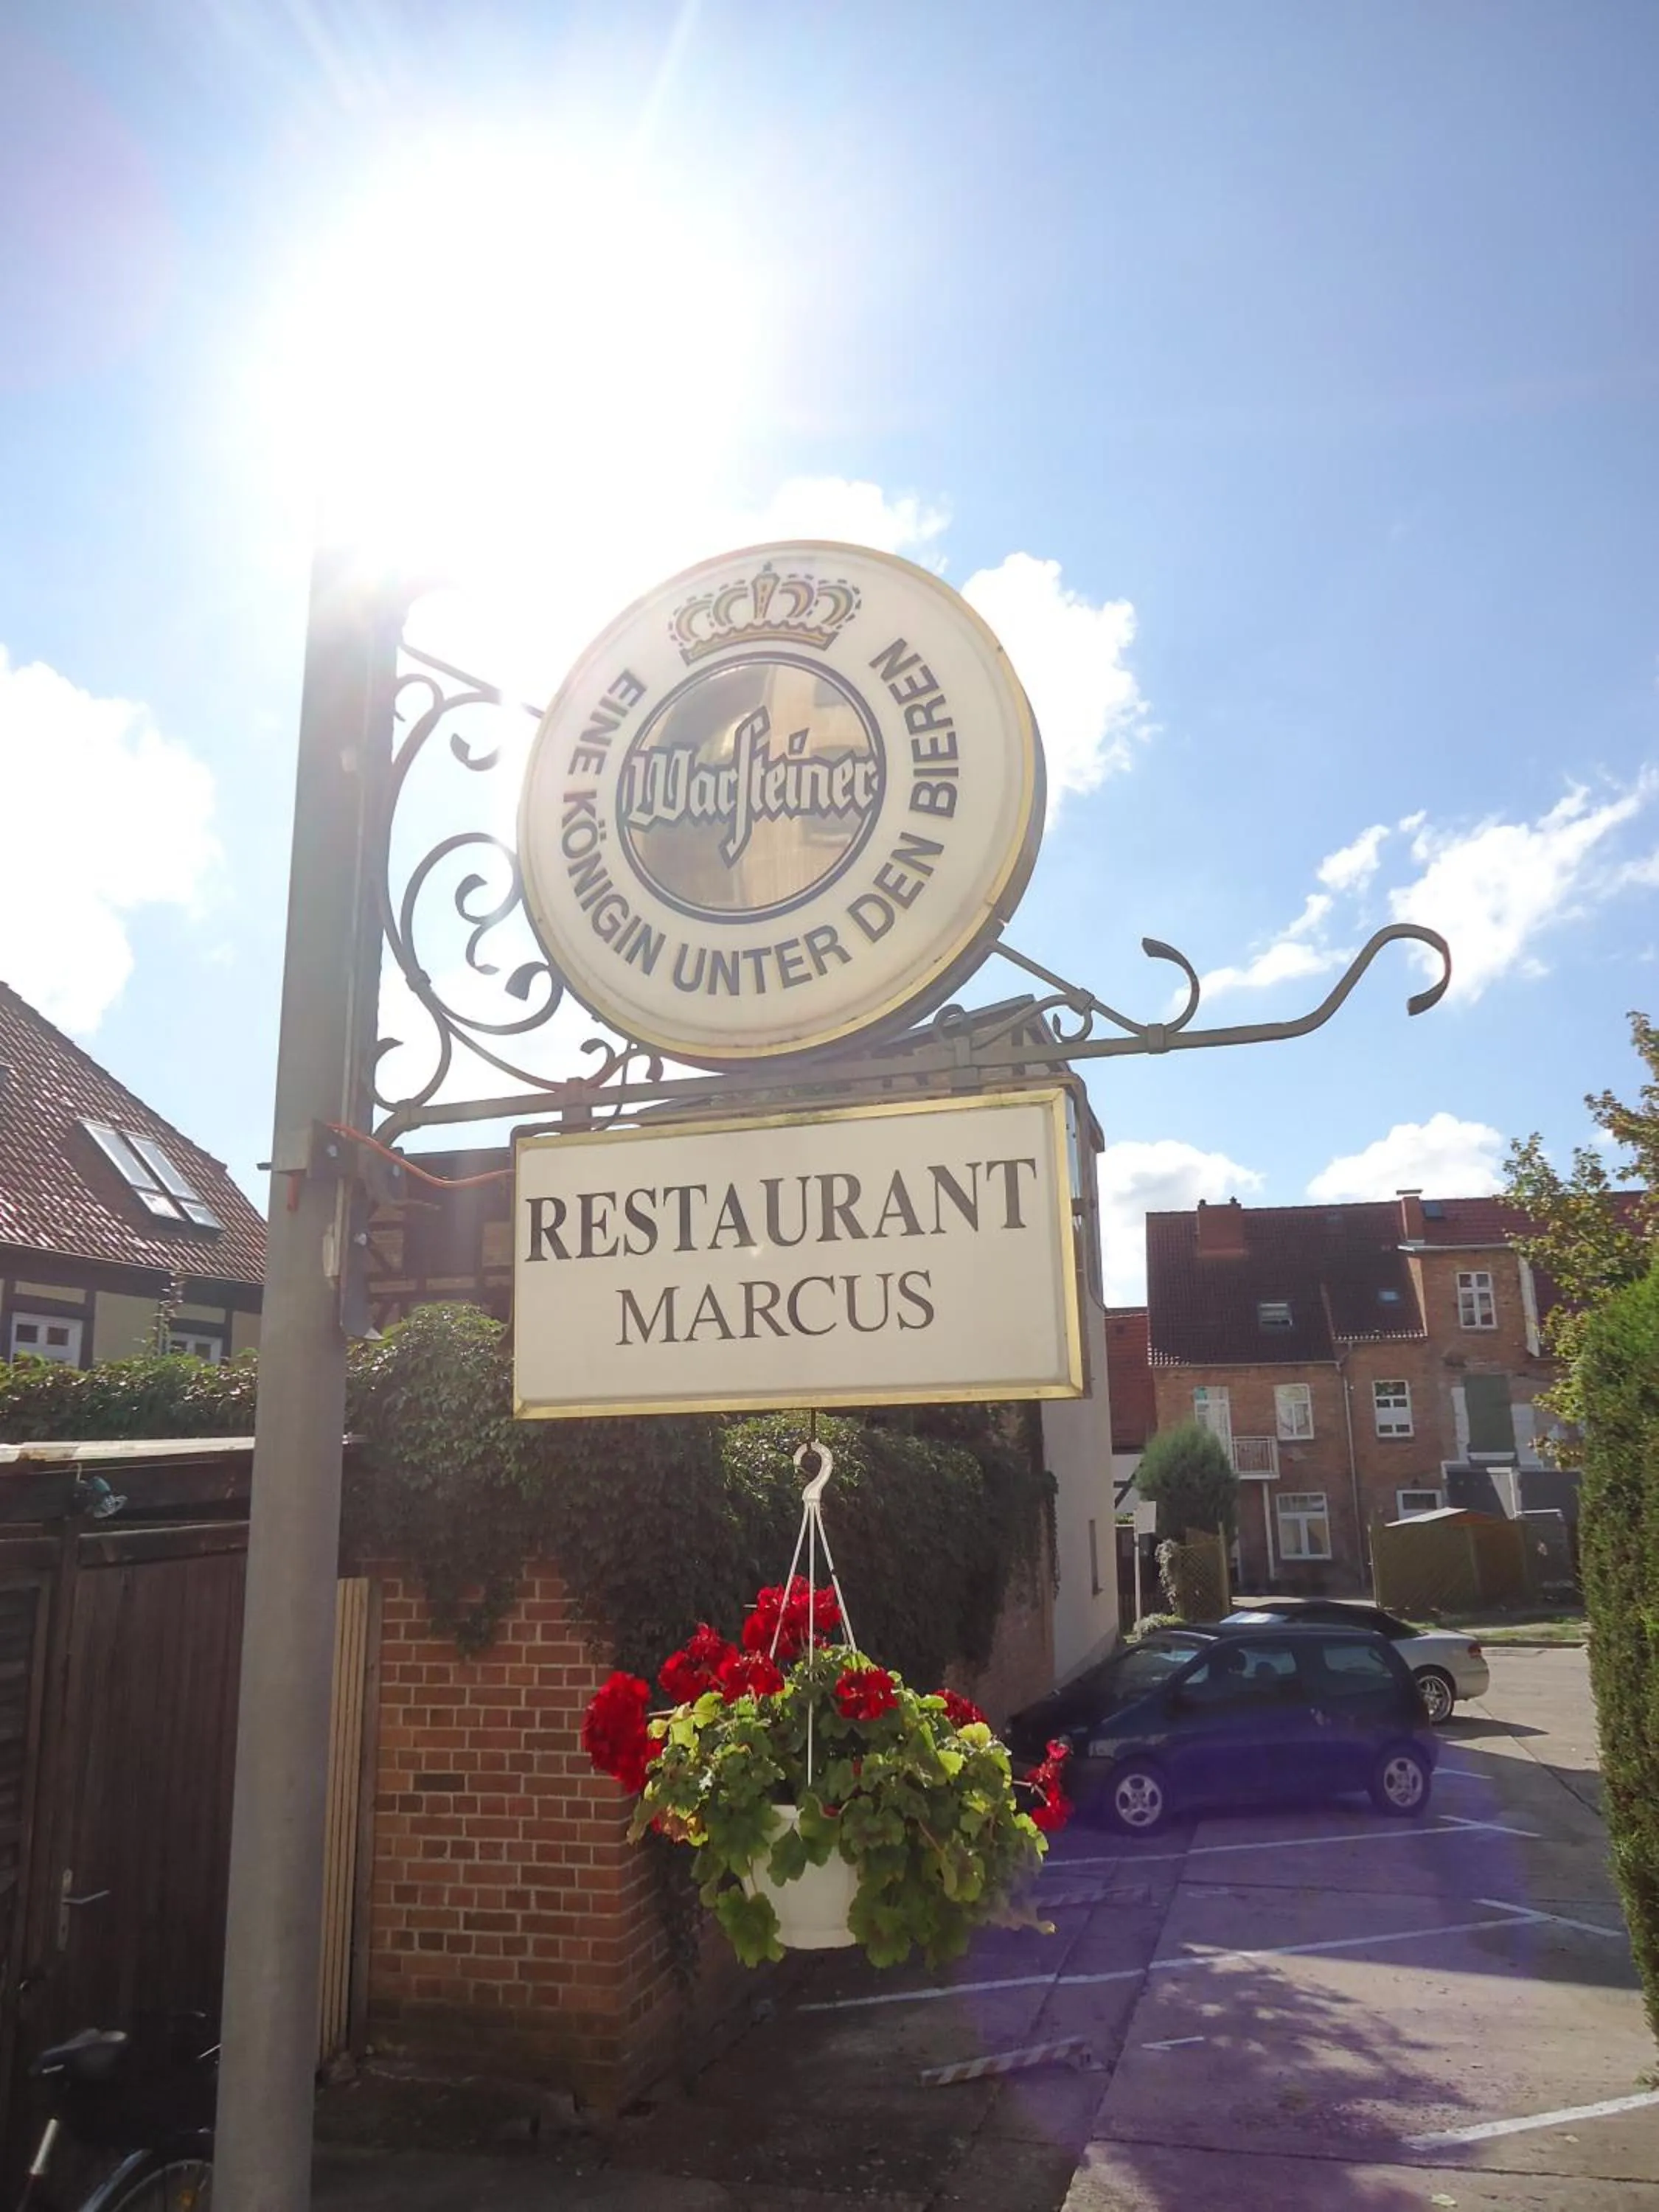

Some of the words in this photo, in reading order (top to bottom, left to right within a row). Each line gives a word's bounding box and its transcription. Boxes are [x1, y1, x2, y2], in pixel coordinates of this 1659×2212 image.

[568, 669, 647, 778] EINE
[869, 637, 959, 818] BIEREN
[623, 705, 881, 869] Warsteiner
[561, 790, 667, 975] KÖNIGIN
[847, 832, 945, 944] DEN
[672, 924, 853, 995] UNTER
[524, 1158, 1037, 1263] RESTAURANT
[615, 1270, 935, 1346] MARCUS
